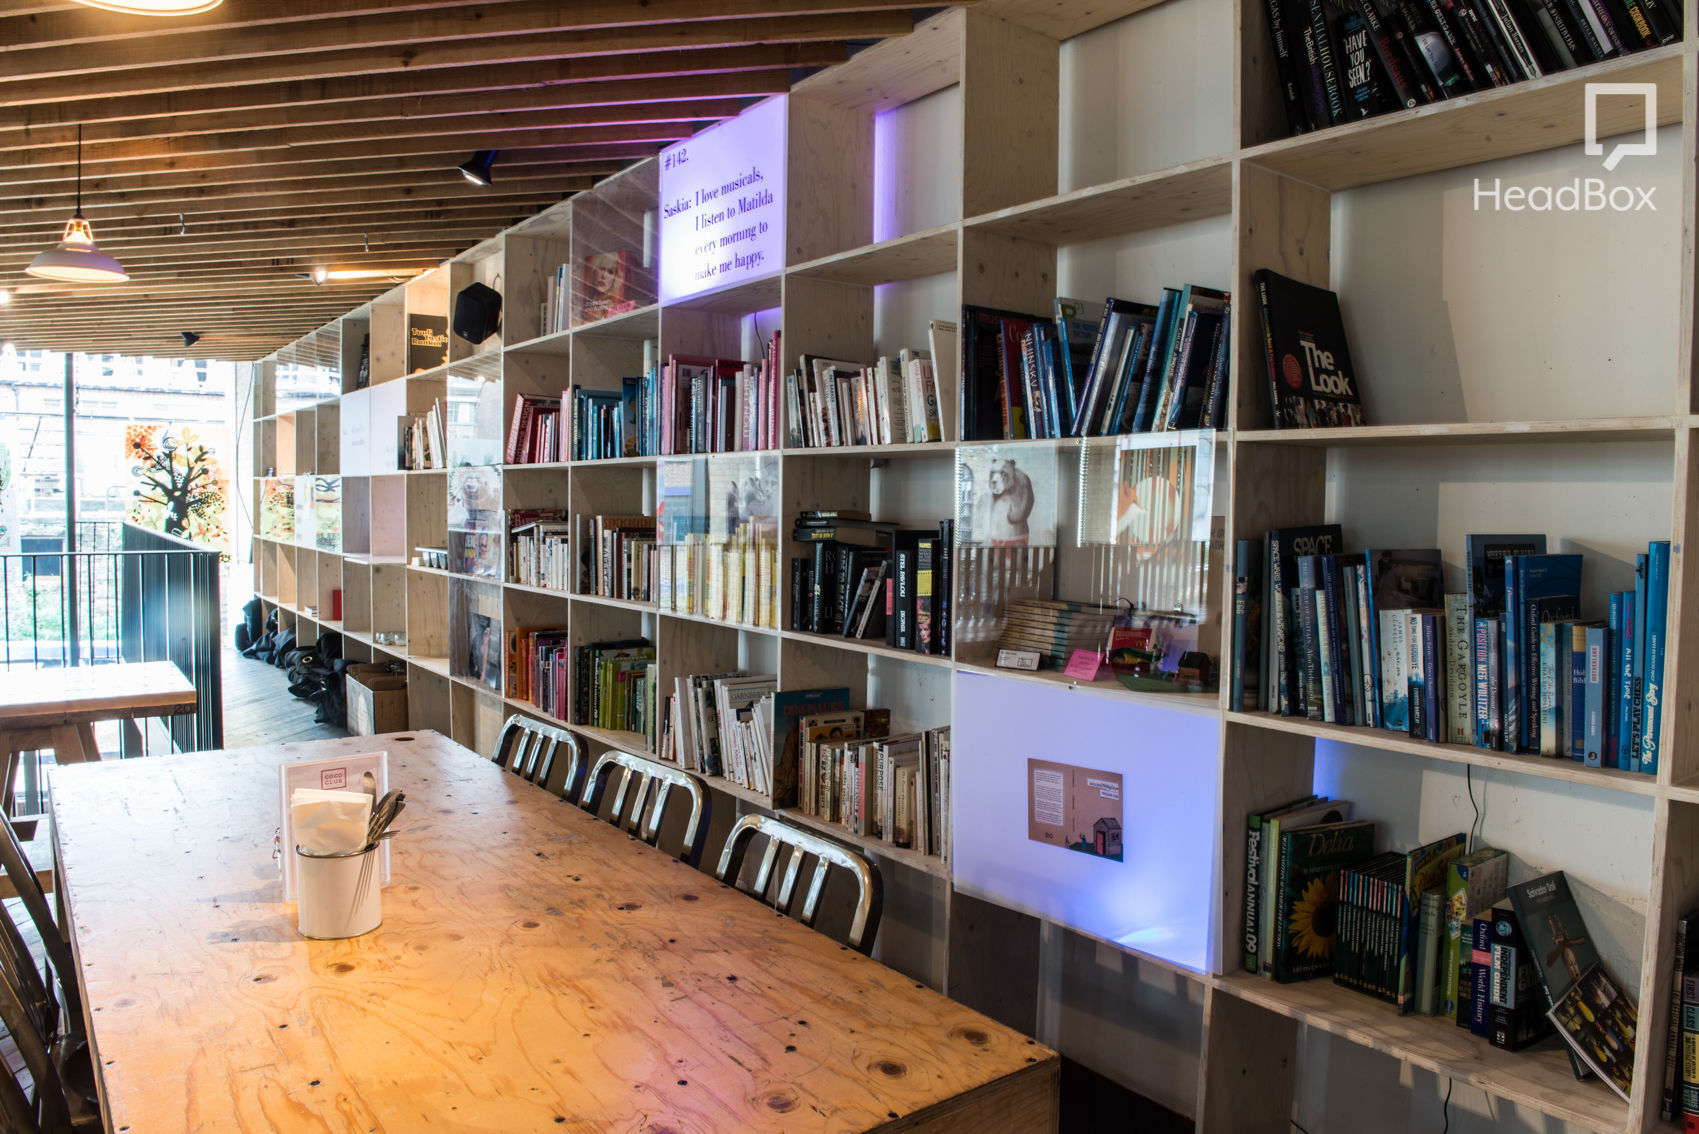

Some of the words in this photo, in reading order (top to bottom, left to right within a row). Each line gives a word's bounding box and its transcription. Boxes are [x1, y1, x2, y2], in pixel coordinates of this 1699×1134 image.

[1362, 2, 1380, 31] CLARKE
[1500, 13, 1516, 34] Julian
[1628, 5, 1652, 39] COOKBOOK
[1275, 29, 1288, 59] himself
[1350, 48, 1365, 67] YOU
[663, 198, 692, 220] Saskia:
[695, 191, 700, 207] I
[701, 188, 719, 204] love
[695, 216, 700, 231] I
[701, 209, 725, 230] listen
[727, 205, 736, 220] to
[738, 188, 774, 215] Matilda
[694, 239, 717, 256] every
[719, 225, 757, 246] morning
[759, 220, 768, 234] to
[719, 258, 733, 273] me
[734, 249, 765, 271] happy.
[1024, 332, 1038, 388] NIJINSKY
[1300, 340, 1335, 370] The
[1309, 366, 1354, 396] Look
[520, 401, 531, 429] DESIGN
[1271, 540, 1279, 561] SPACE
[1293, 535, 1333, 556] SPACE
[1235, 599, 1246, 615] EGG
[1409, 616, 1417, 624] NO
[1456, 604, 1469, 635] THE
[1306, 648, 1314, 664] Alan
[1476, 628, 1488, 661] POSITION
[1624, 647, 1632, 660] All
[1456, 639, 1470, 720] GARGOYLE
[1476, 664, 1487, 680] MEG
[1572, 668, 1586, 676] Hol
[1624, 663, 1632, 678] the
[1476, 682, 1489, 719] WOLITZER
[1623, 680, 1631, 699] Time
[1632, 676, 1642, 706] CHESS
[1645, 681, 1658, 705] Story
[783, 702, 845, 717] DINOSAURS
[1632, 706, 1640, 731] PLAY
[1642, 704, 1657, 750] Paramount
[1631, 732, 1640, 759] LET'S
[1642, 749, 1653, 765] The
[877, 752, 885, 792] PURPOSE
[1307, 829, 1355, 858] Delia
[1247, 829, 1261, 886] Festival
[1245, 883, 1258, 931] ANNUAL
[1245, 932, 1257, 954] 09
[1477, 922, 1487, 950] Oxford
[1477, 967, 1486, 991] World
[1686, 979, 1695, 1000] FIRST
[1474, 993, 1485, 1024] History
[1686, 1006, 1694, 1028] CLASS
